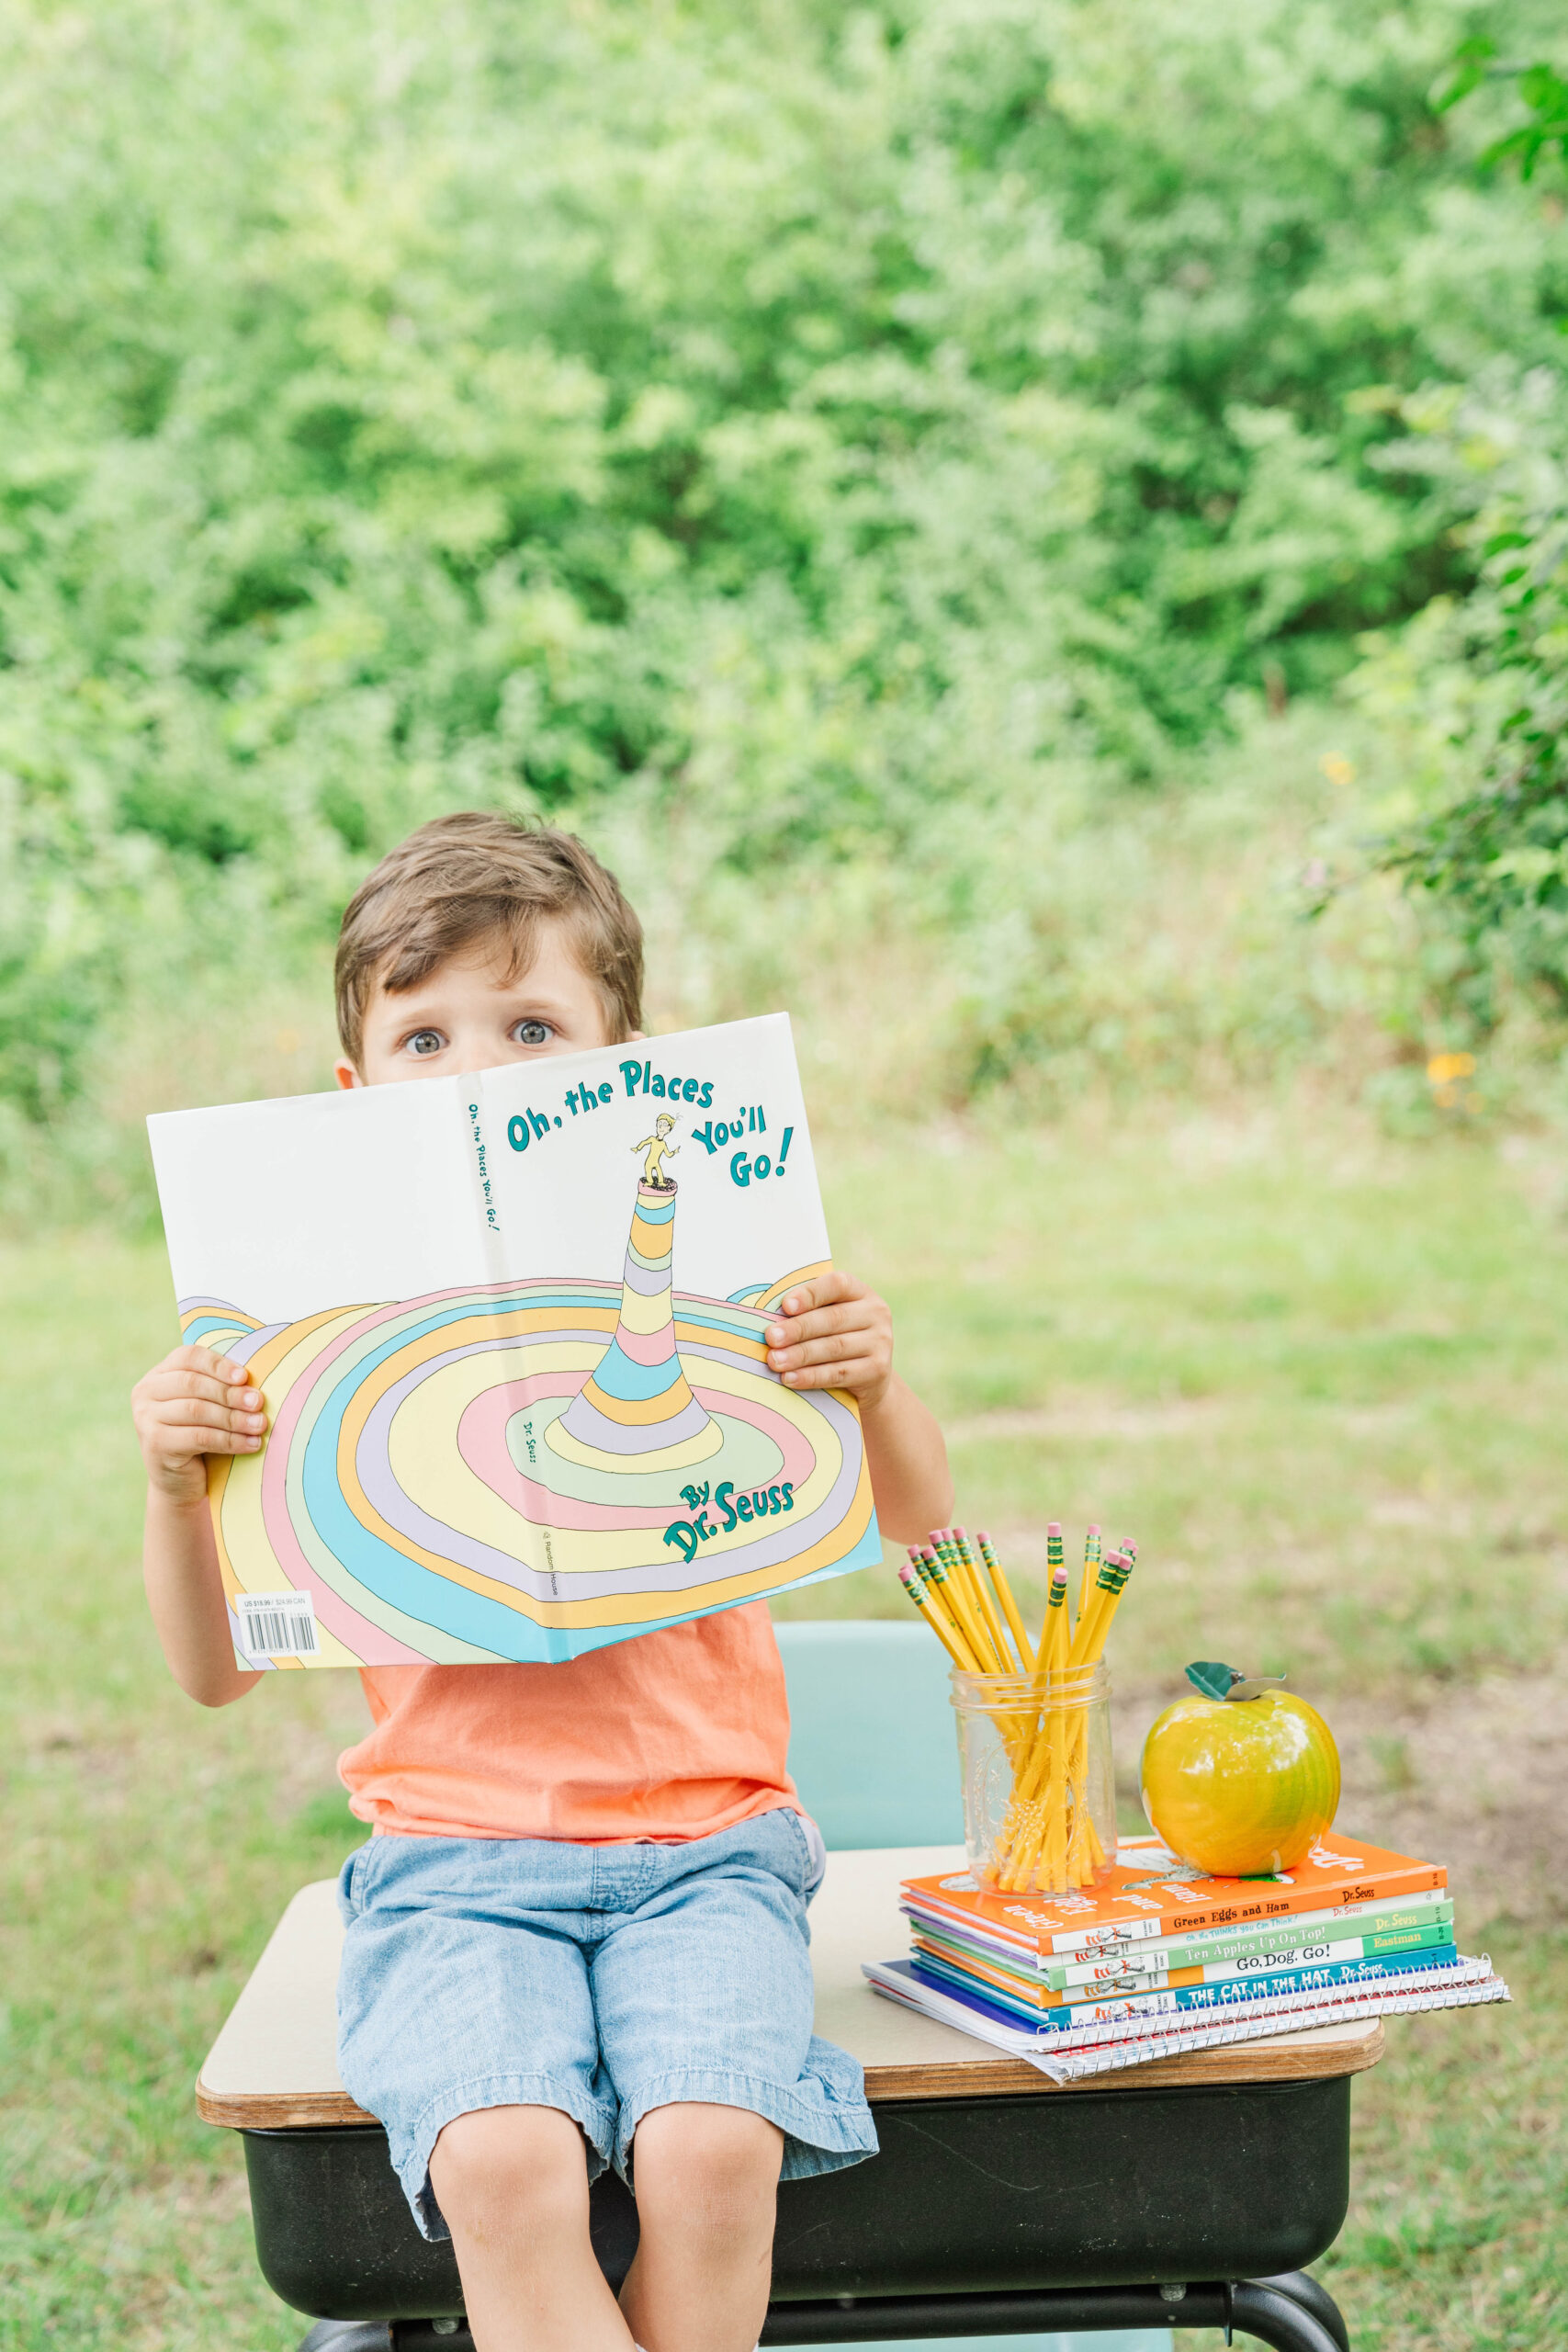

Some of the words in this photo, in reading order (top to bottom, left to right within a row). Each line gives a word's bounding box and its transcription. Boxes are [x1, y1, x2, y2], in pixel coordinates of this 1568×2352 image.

[468, 1103, 479, 1125] Oh,
[507, 1107, 562, 1152] Oh,
[564, 1081, 614, 1116] the
[619, 1059, 715, 1109] Places
[473, 1125, 481, 1143] the
[691, 1105, 767, 1155] You'll
[476, 1145, 487, 1177] Places
[730, 1126, 795, 1187] Go!
[482, 1179, 493, 1204] You'll
[486, 1208, 501, 1231] Go!
[524, 1421, 533, 1438] Dr.
[525, 1440, 536, 1464] Seuss
[679, 1480, 710, 1510] By
[663, 1511, 718, 1564] Dr.
[715, 1481, 795, 1532] Seuss
[545, 1541, 554, 1570] Random
[550, 1574, 558, 1596] House
[1003, 1905, 1064, 1929] Green
[1111, 1894, 1164, 1910] and
[1161, 1883, 1213, 1904] Ham
[1174, 1915, 1206, 1928] Green
[1211, 1908, 1237, 1923] Eggs
[1242, 1905, 1262, 1917] and
[1266, 1902, 1290, 1914] Ham
[1333, 1907, 1344, 1917] Dr.
[1344, 1905, 1362, 1916] Seuss
[1208, 1926, 1237, 1939] THINKS
[1375, 1917, 1391, 1931] Dr.
[1392, 1914, 1417, 1927] Seuss
[1184, 1948, 1209, 1962] Ten
[1213, 1941, 1256, 1958] Apples
[1259, 1936, 1276, 1949] Up
[1279, 1932, 1297, 1945] On
[1299, 1926, 1326, 1942] Top!
[1373, 1932, 1422, 1949] Eastman
[1236, 1957, 1263, 1971] Go,
[1263, 1950, 1298, 1966] Dog.
[1303, 1943, 1331, 1960] Go!
[1188, 1988, 1215, 2002] THE
[1221, 1982, 1247, 1998] CAT
[1253, 1980, 1267, 1993] IN
[1271, 1976, 1296, 1989] THE
[1302, 1968, 1331, 1983] HAT
